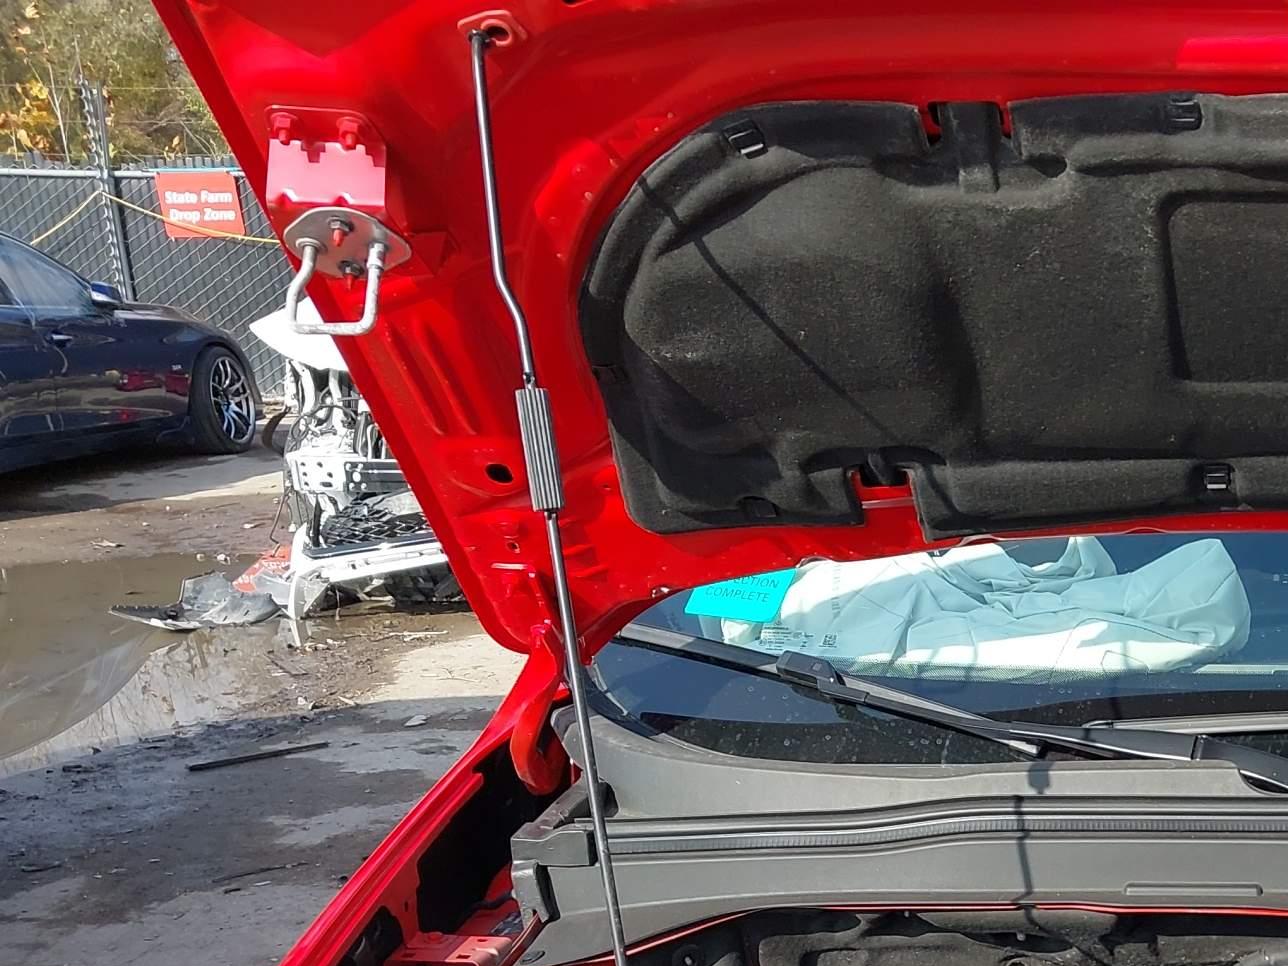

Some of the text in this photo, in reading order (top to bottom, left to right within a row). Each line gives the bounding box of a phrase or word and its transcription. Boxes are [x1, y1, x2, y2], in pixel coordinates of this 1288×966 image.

[164, 189, 233, 205] State Farm
[169, 207, 236, 224] Drop Zone
[705, 585, 771, 603] COMPLETE
